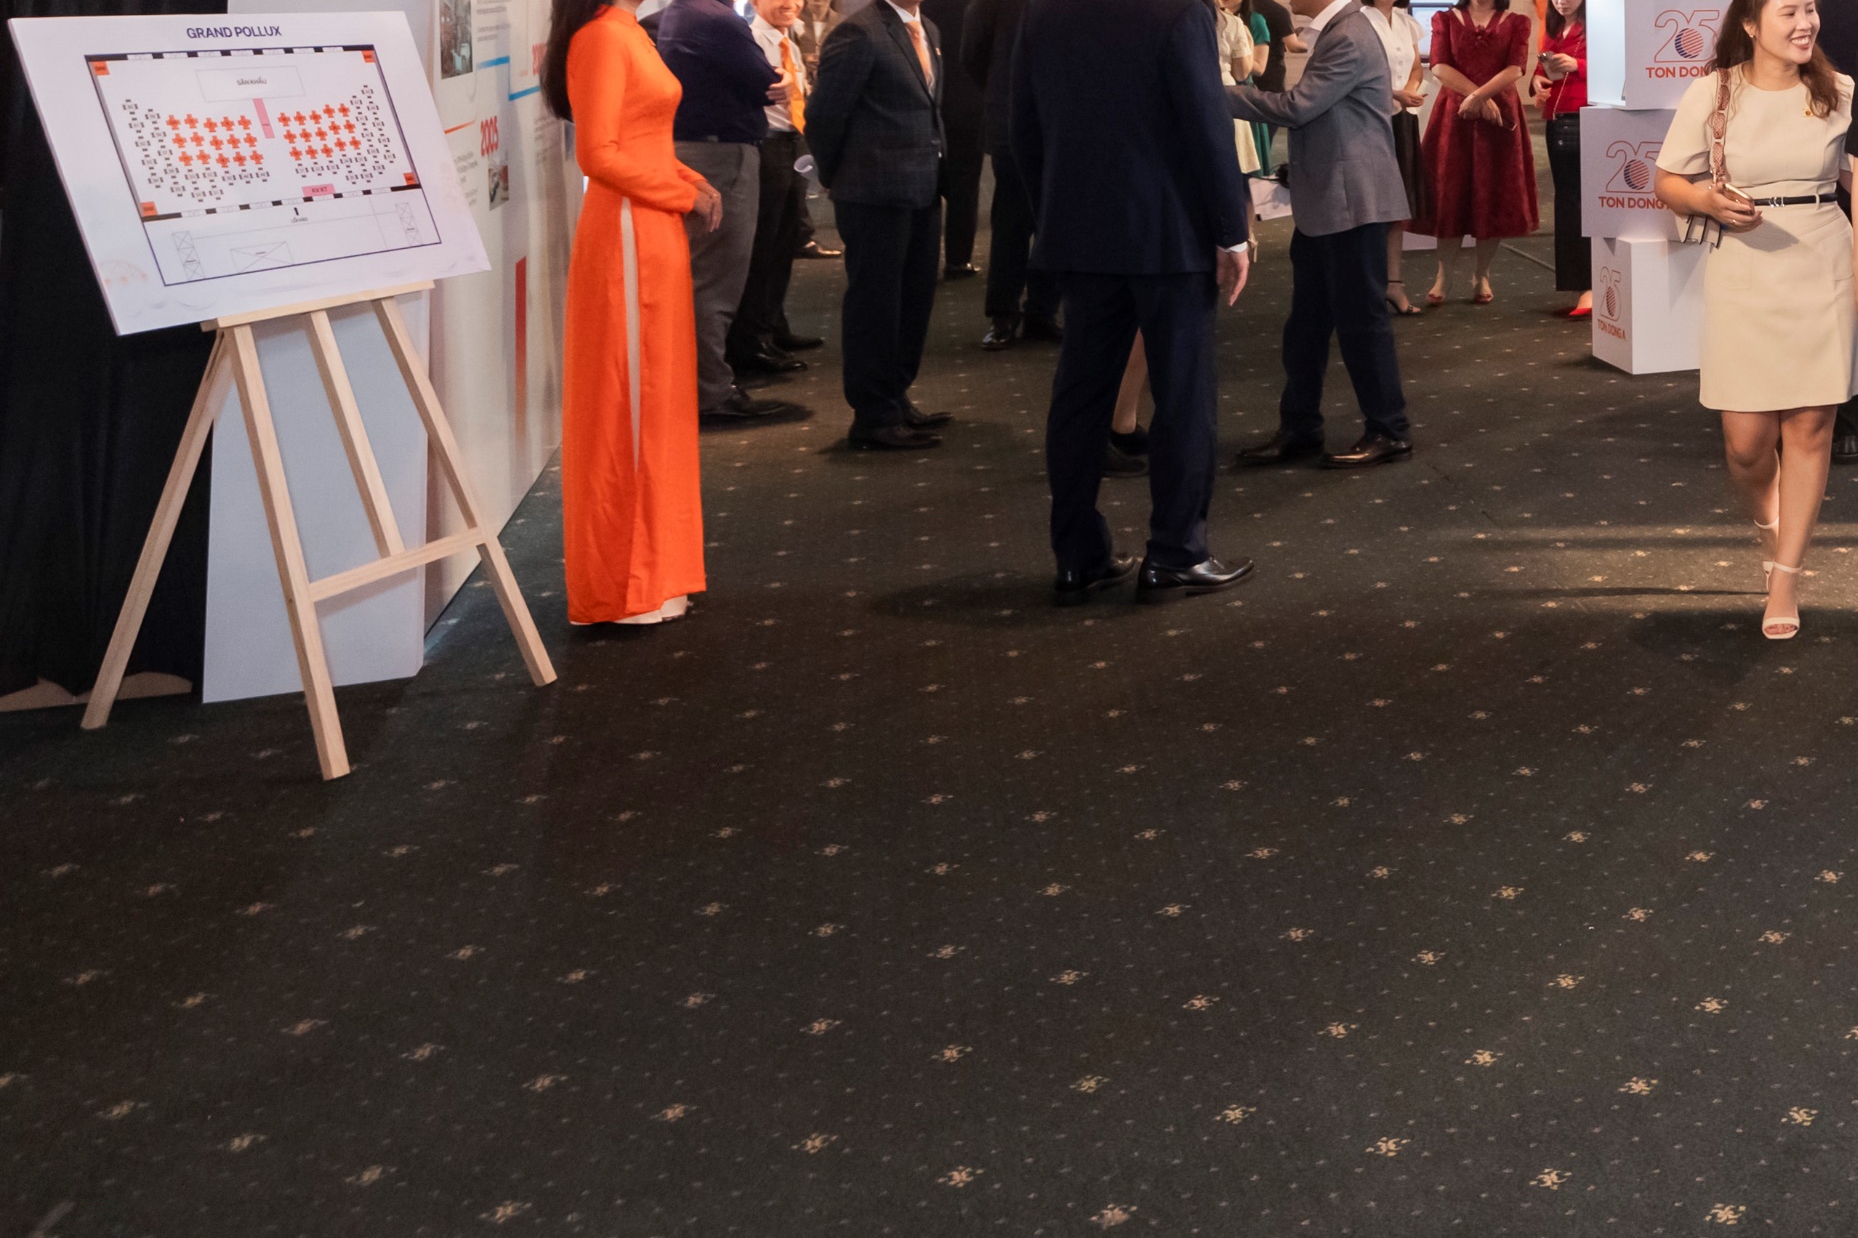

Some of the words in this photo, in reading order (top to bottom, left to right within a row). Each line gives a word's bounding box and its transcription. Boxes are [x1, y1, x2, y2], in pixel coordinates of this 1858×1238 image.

[187, 27, 232, 39] GRAND
[235, 26, 282, 37] POLLUX
[1654, 10, 1719, 63] 25
[1646, 67, 1675, 78] TON
[1599, 197, 1624, 208] TON
[1600, 266, 1621, 322] 25
